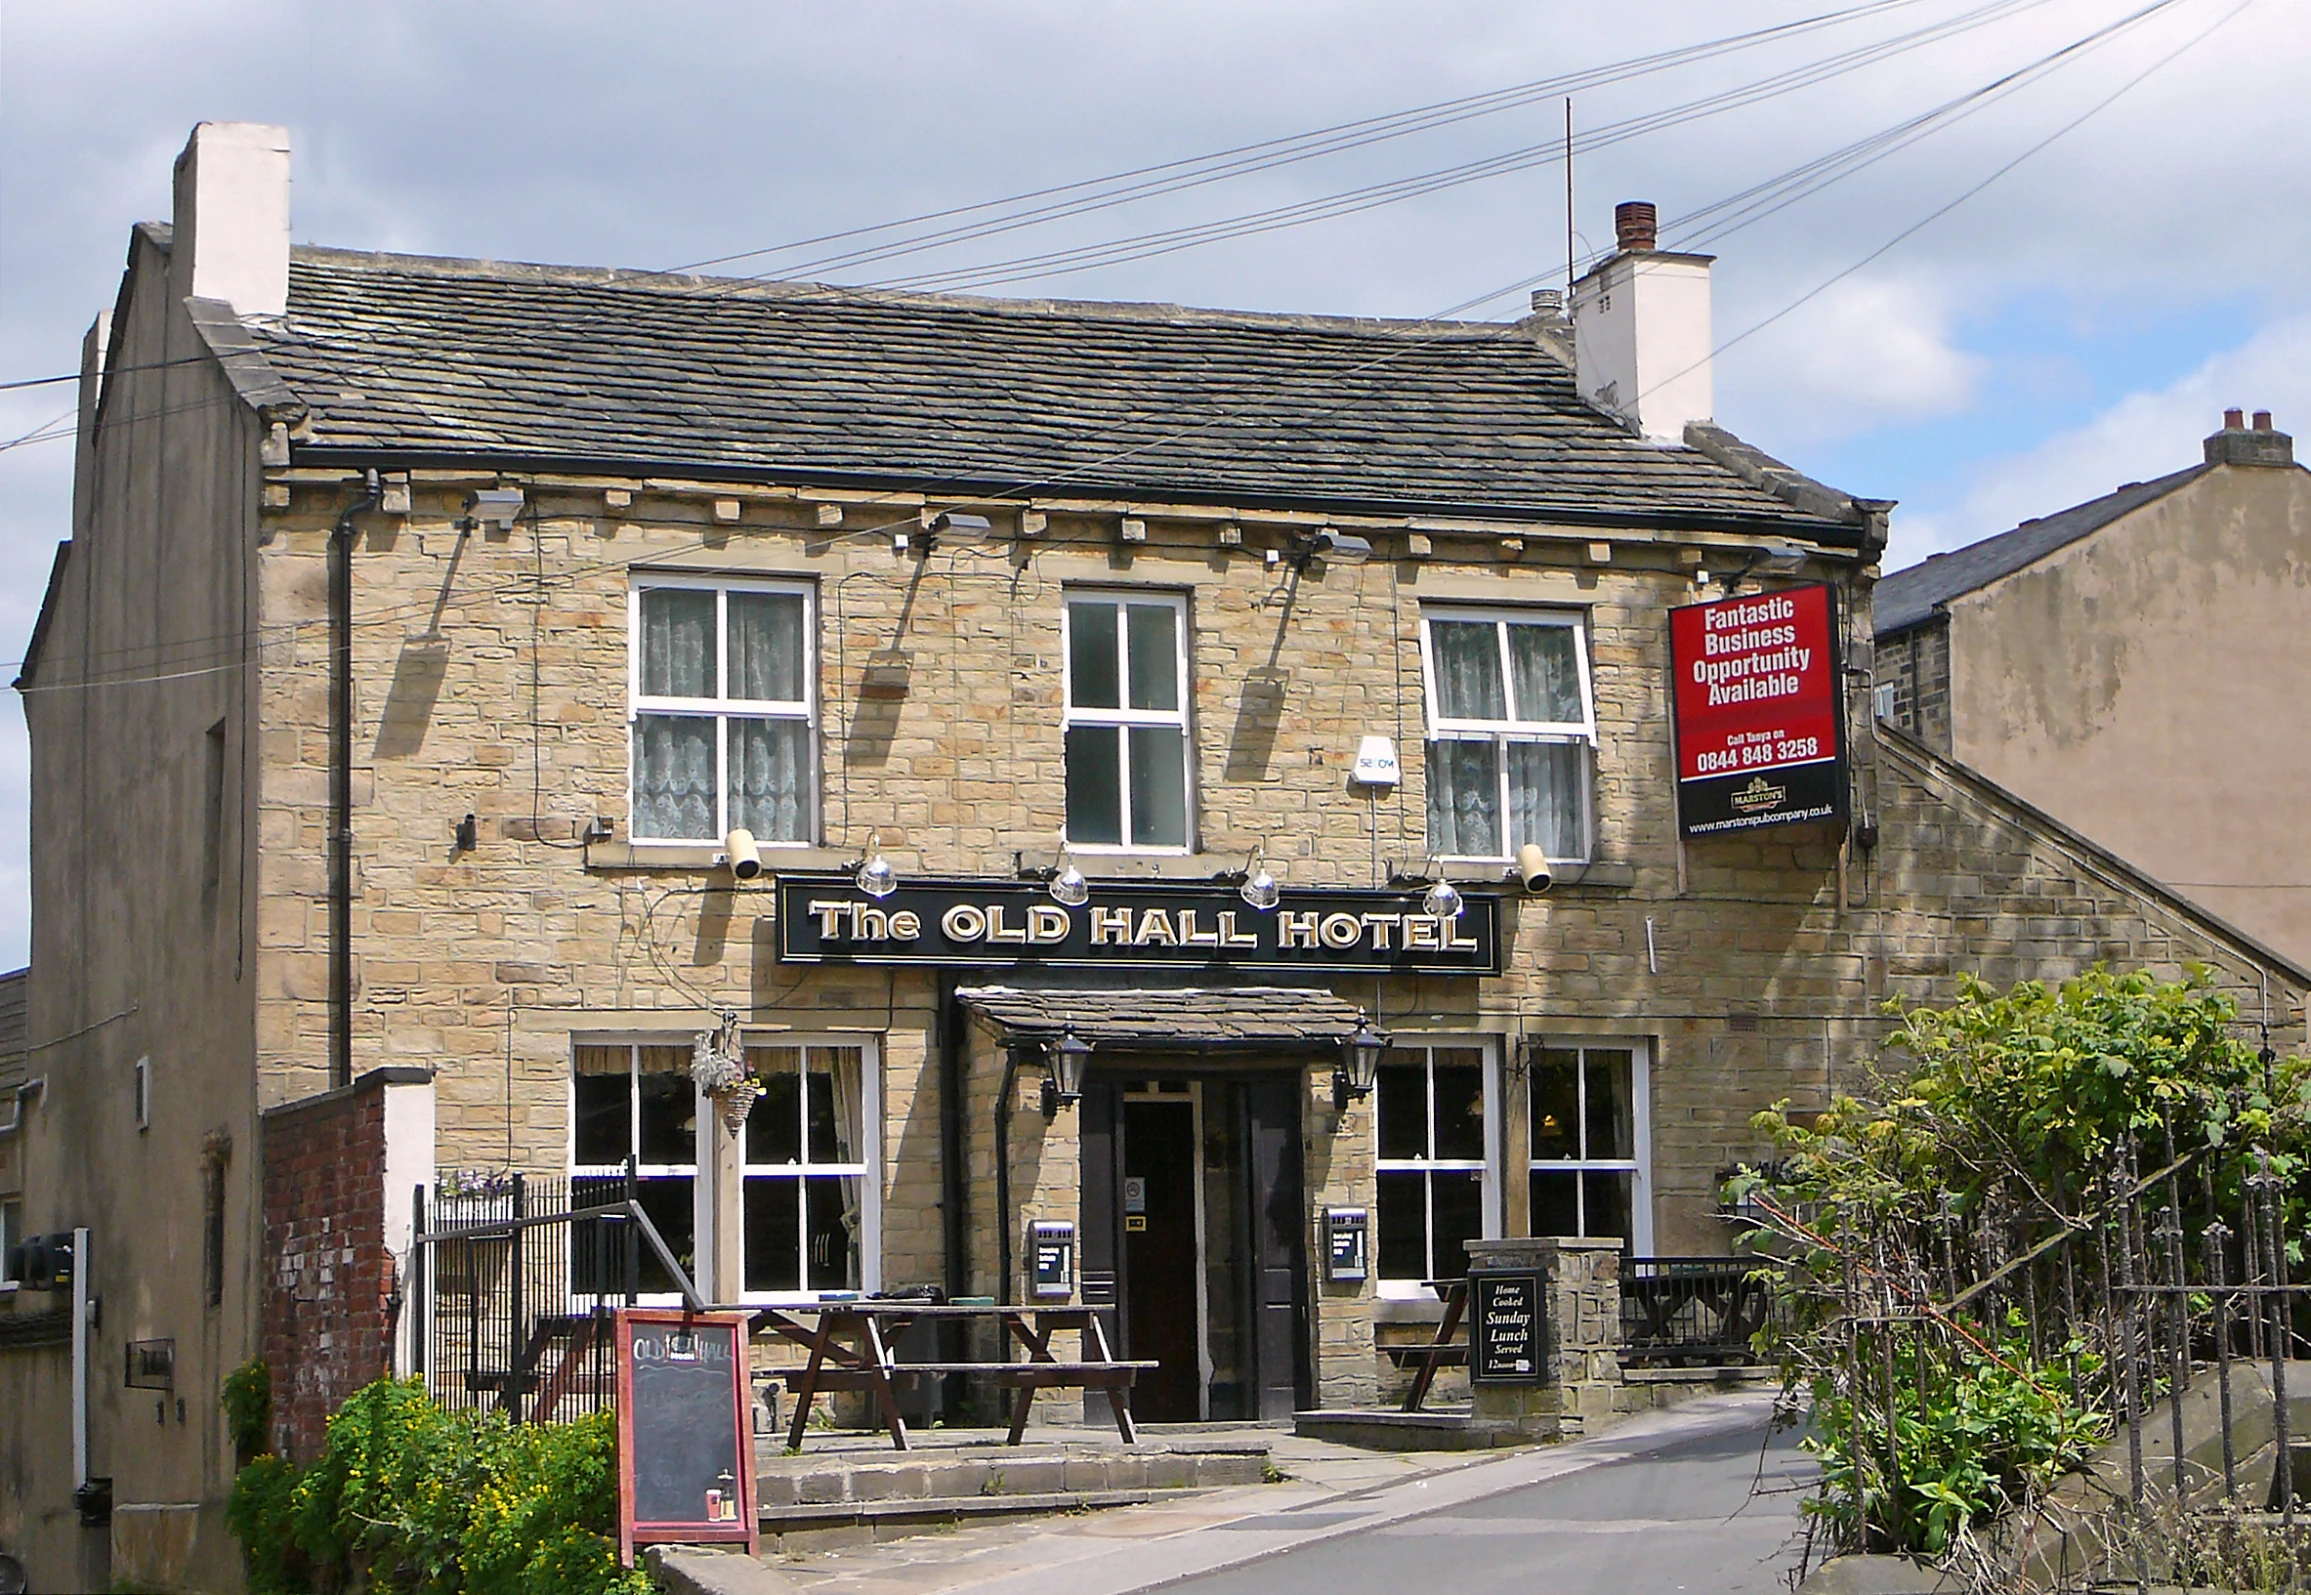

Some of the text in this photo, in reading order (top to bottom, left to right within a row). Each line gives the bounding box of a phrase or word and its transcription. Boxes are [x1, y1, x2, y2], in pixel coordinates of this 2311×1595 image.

[1704, 596, 1794, 632] Fantastic
[1705, 624, 1796, 656] Business
[1693, 647, 1811, 685] Opportunity
[1707, 673, 1800, 706] Available
[1727, 729, 1785, 746] Call Tanya on
[1696, 736, 1818, 773] 0844 848 3258
[1688, 803, 1833, 834] www.marstonspubcompany.co.uk
[808, 900, 1478, 953] The OLD HALL HOTEL
[1492, 1296, 1524, 1307] Cooked
[1495, 1285, 1520, 1295] Home
[1486, 1310, 1530, 1326] Sunday
[1490, 1328, 1528, 1342] Lunch
[633, 1337, 665, 1361] OLD
[1494, 1344, 1523, 1354] Served
